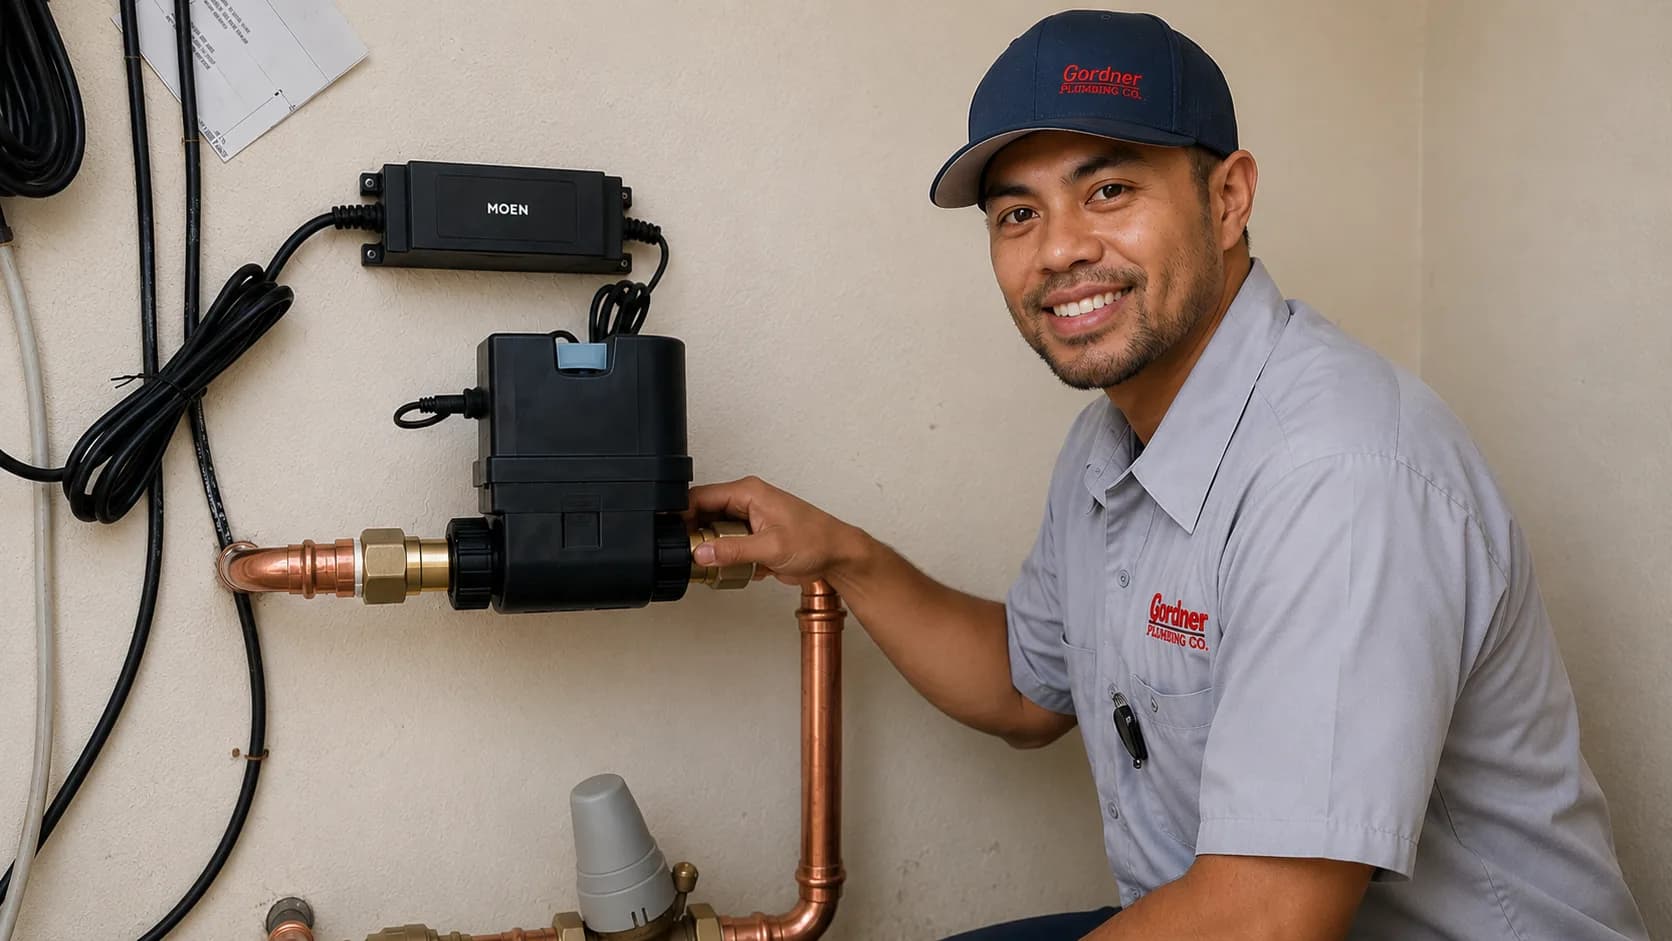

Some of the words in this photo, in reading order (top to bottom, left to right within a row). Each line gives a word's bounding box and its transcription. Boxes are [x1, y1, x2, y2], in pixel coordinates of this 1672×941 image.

[1063, 64, 1143, 85] Gordner
[1060, 83, 1119, 95] PLUMBING
[487, 202, 529, 216] MOEN
[1149, 592, 1209, 632] Gordner
[1146, 624, 1186, 647] PLUMBING
[1189, 636, 1209, 651] CO.
